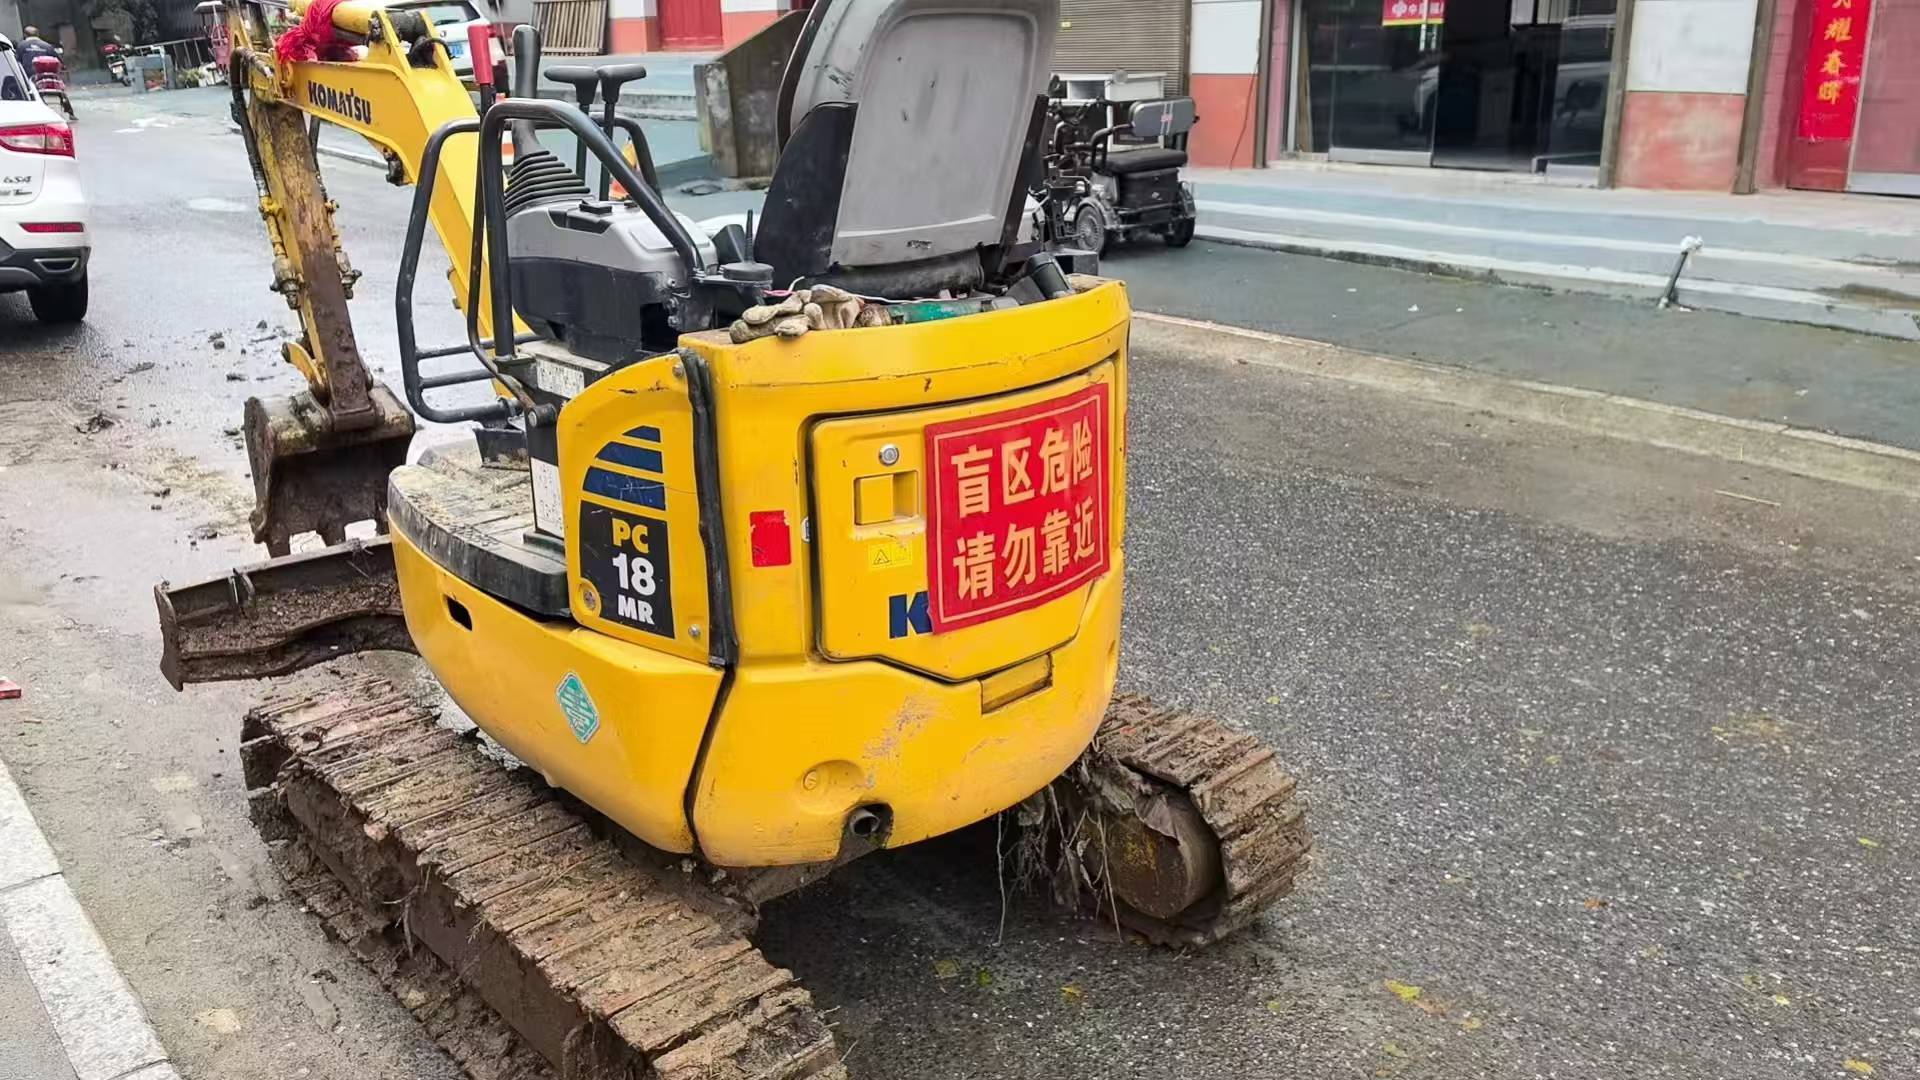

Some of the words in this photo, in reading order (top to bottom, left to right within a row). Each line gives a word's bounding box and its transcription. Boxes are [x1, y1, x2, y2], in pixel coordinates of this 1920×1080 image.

[307, 80, 372, 125] KOMATSU
[950, 416, 1094, 519] 盲区危险
[611, 517, 650, 554] PC
[952, 496, 1096, 601] 请勿靠近
[612, 552, 656, 597] 18
[617, 594, 655, 625] MR
